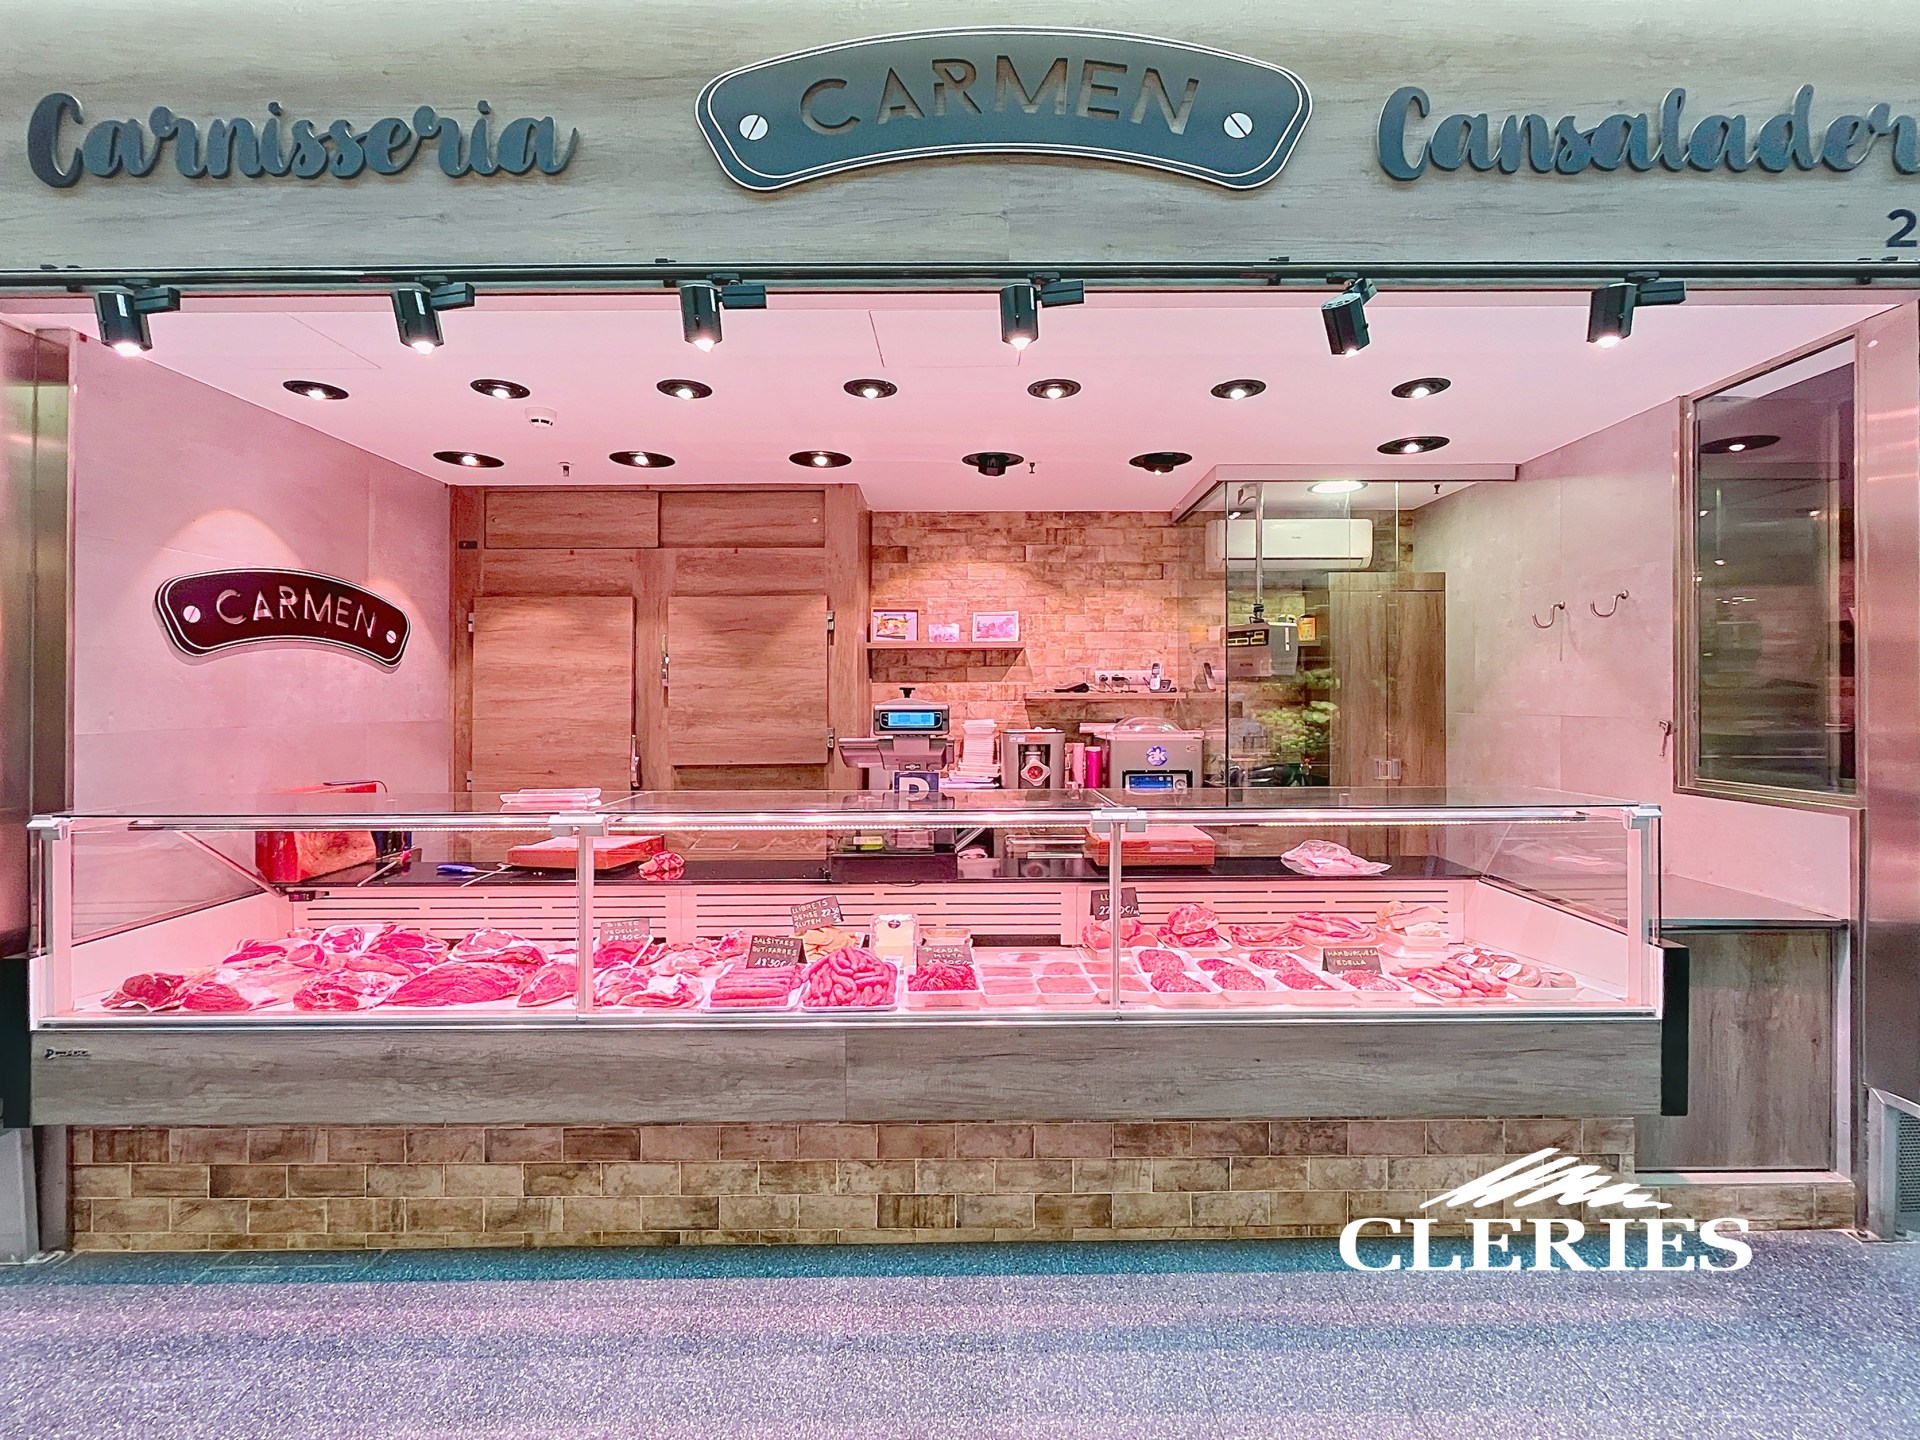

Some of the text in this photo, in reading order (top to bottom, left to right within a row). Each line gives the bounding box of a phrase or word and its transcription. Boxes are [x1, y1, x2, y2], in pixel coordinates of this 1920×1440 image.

[800, 55, 1199, 136] CARMEN
[27, 92, 579, 188] Carnisseria
[1886, 208, 1917, 248] 2
[215, 585, 378, 639] CARMEN
